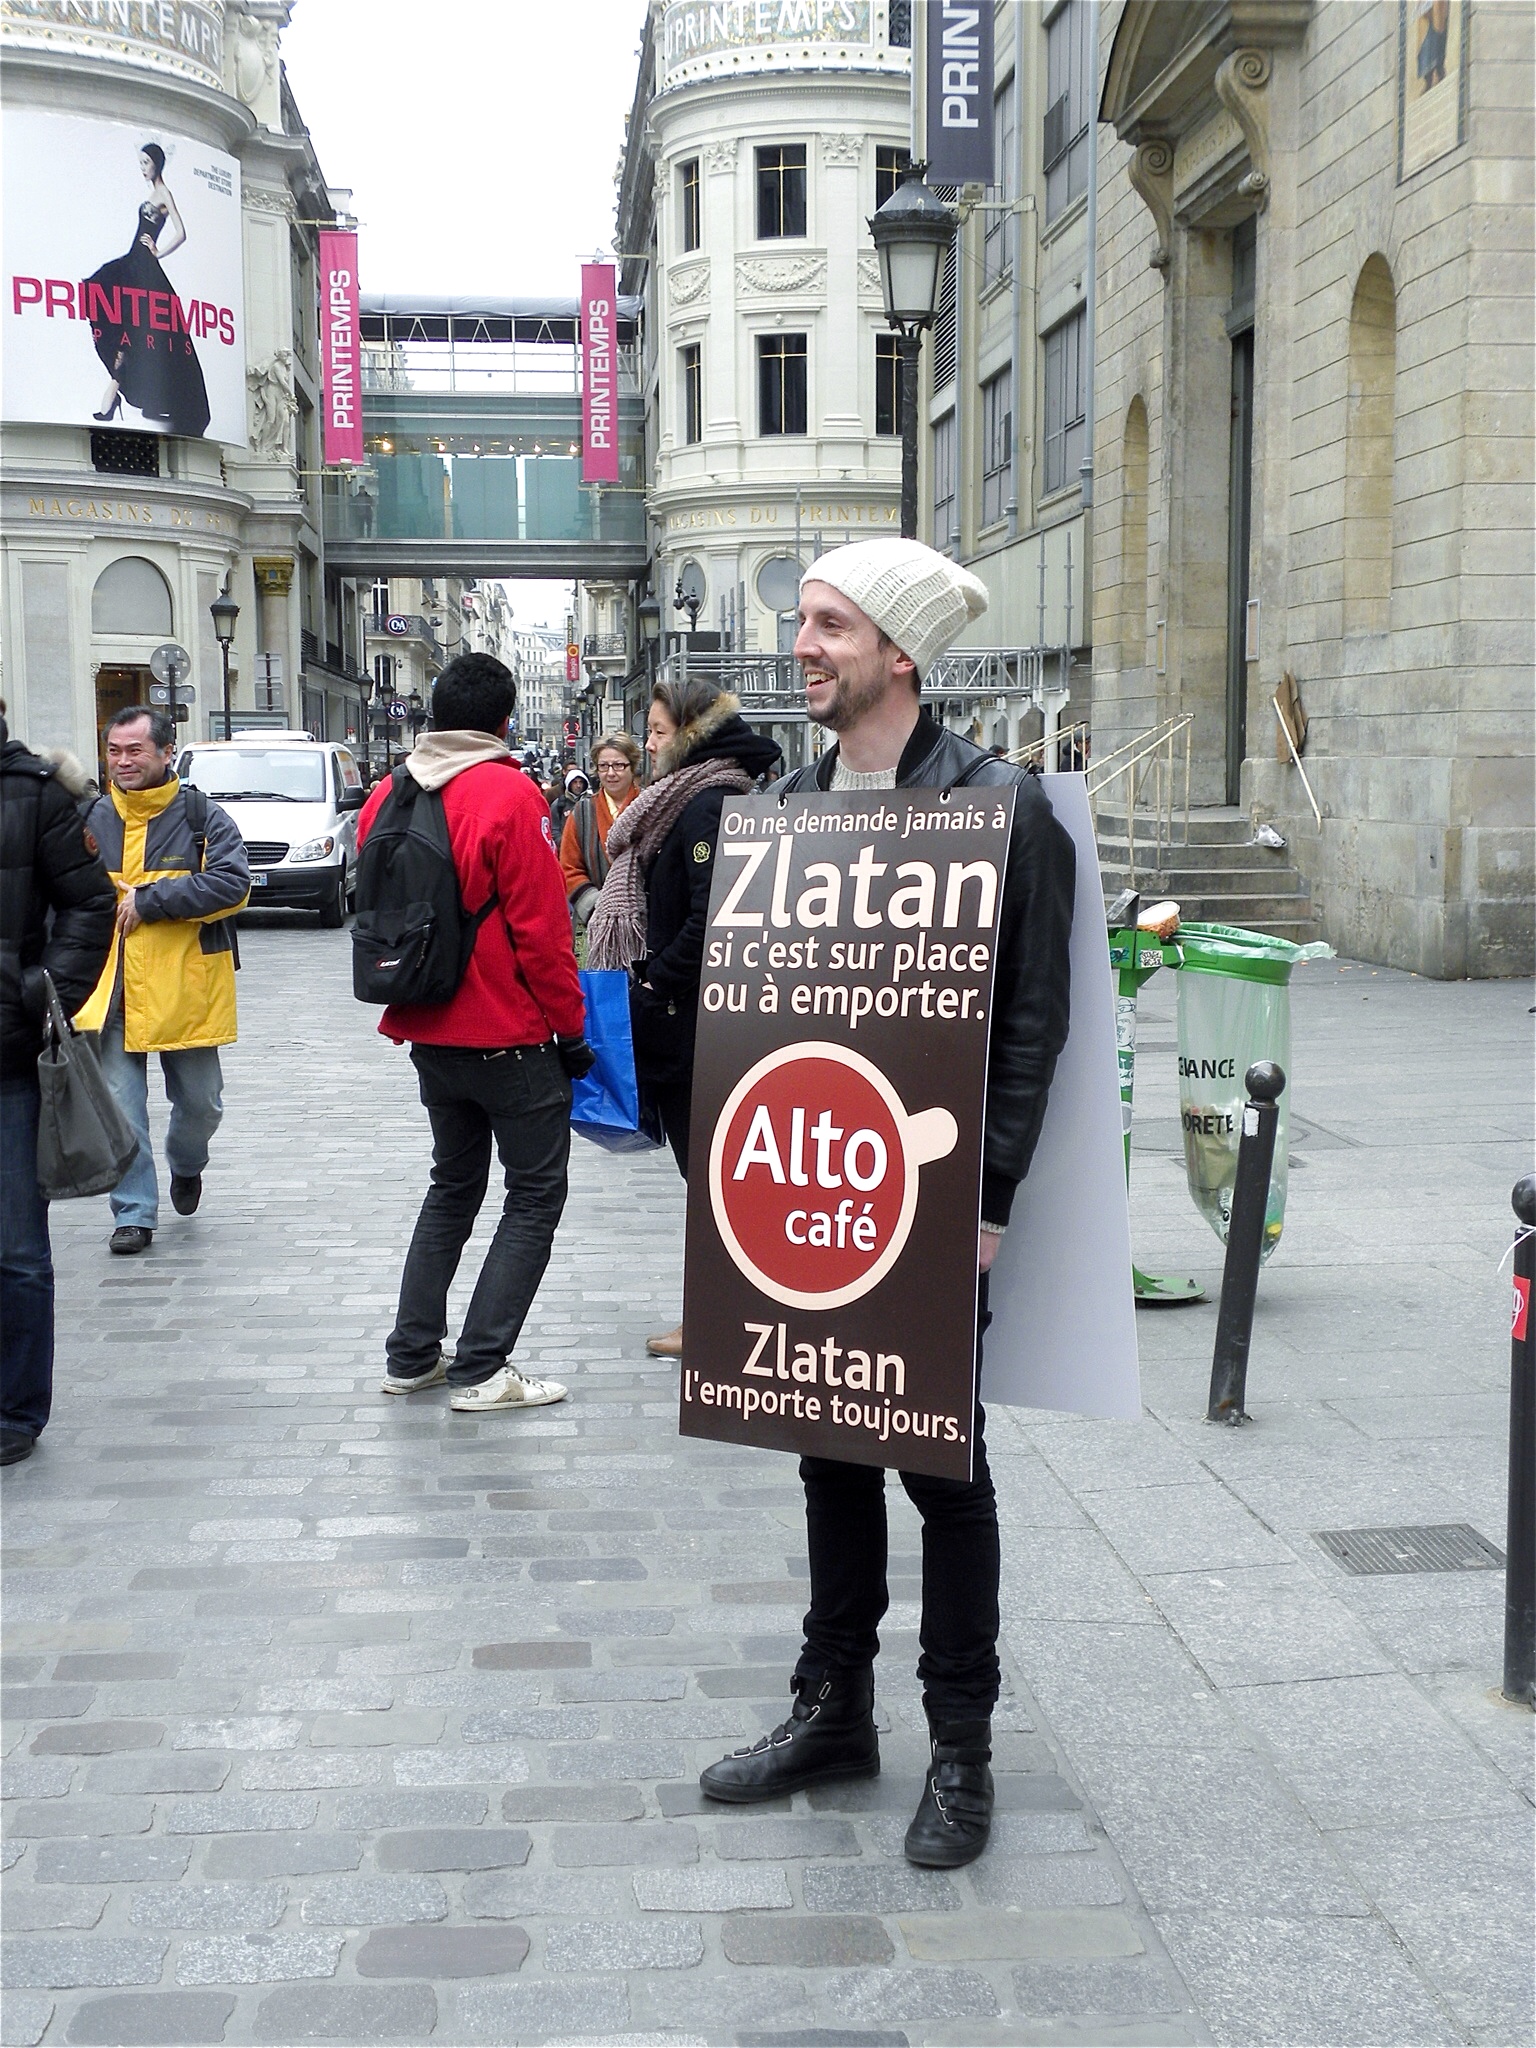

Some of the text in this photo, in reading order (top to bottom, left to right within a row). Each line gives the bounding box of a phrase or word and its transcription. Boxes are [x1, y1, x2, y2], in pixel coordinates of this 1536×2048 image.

[675, 0, 857, 55] PRINTEMPS
[942, 0, 979, 128] PRIN
[12, 276, 235, 347] PRINTEMPS
[95, 328, 194, 355] PARIS
[329, 269, 354, 428] PRINTEMPS
[589, 299, 611, 449] PRINTEMPS
[29, 497, 153, 524] MAGASINS
[171, 507, 193, 526] DU
[750, 507, 778, 524] DU
[723, 804, 1007, 838] On ne demande jamais à
[711, 835, 998, 929] Zlatan
[707, 930, 991, 983] si c'est sur place
[703, 973, 986, 1029] ou à emporter.
[732, 1104, 888, 1192] Alto
[785, 1199, 878, 1252] café
[742, 1321, 906, 1396] Zlatan
[684, 1369, 968, 1443] l'emporte toujours.
